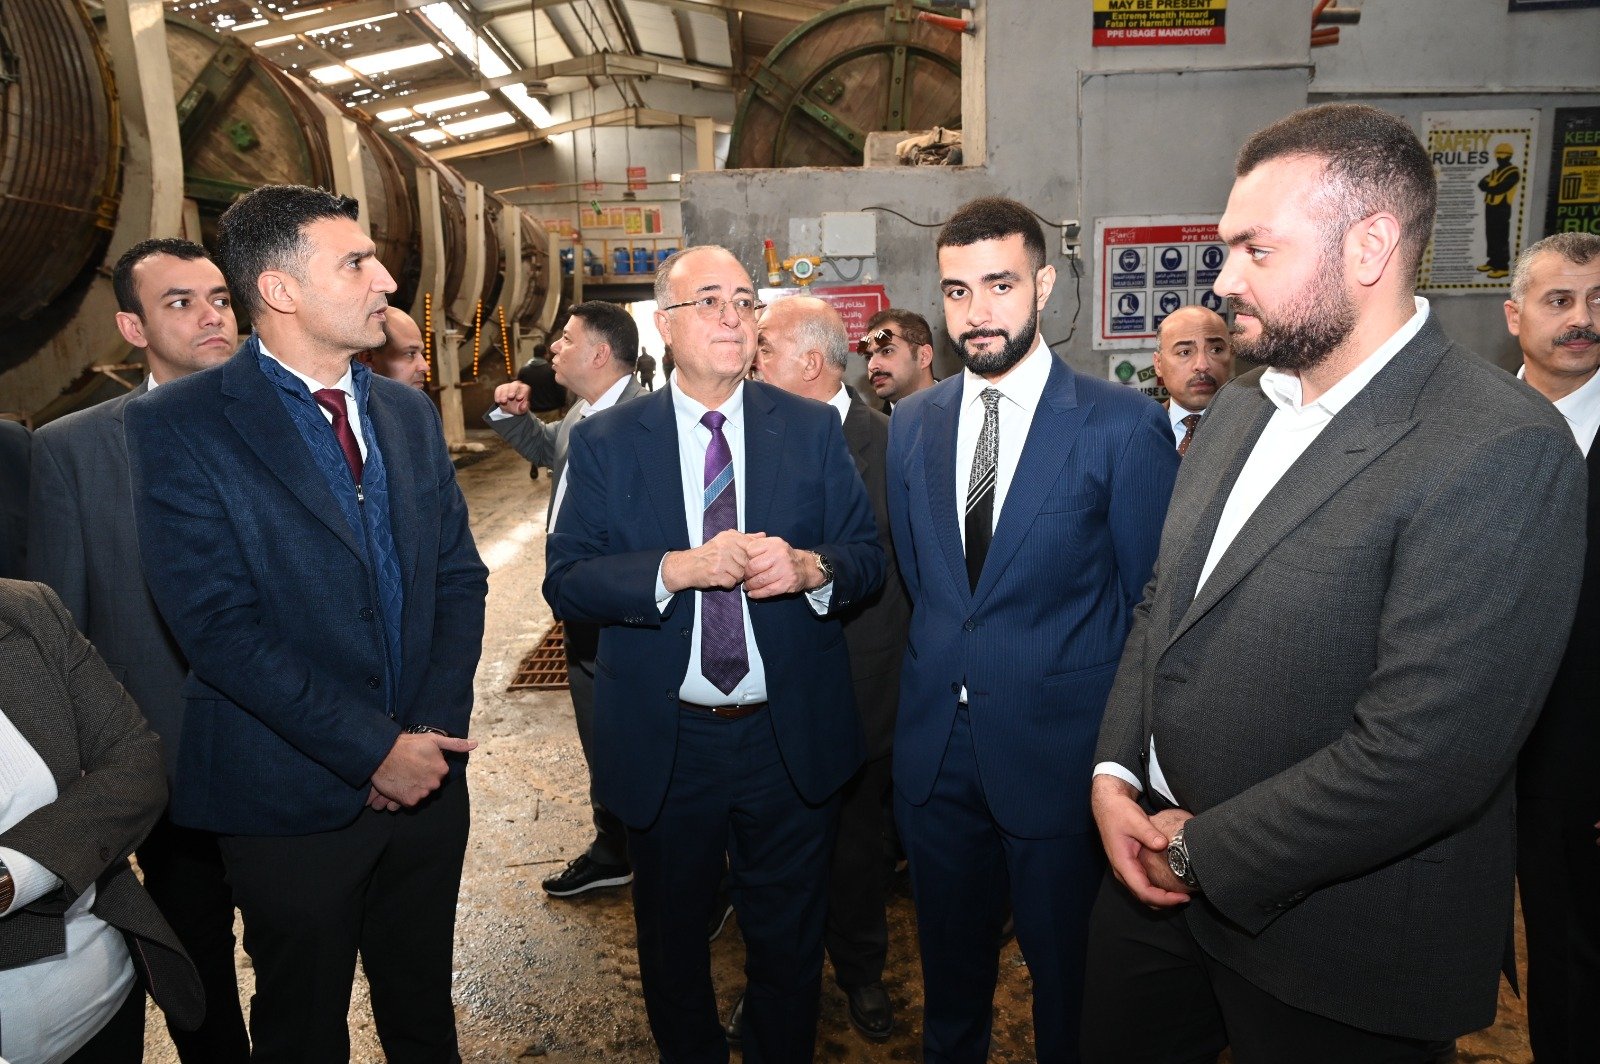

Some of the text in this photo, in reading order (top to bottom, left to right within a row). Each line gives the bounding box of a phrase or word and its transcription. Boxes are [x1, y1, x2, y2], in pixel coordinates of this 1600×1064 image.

[1108, 0, 1212, 10] MAY BE PRESENT
[1112, 10, 1209, 20] Extreme Health Hazard
[1107, 30, 1124, 38] PPE
[1158, 28, 1212, 37] MANDATORY
[1433, 133, 1492, 152] SAFETY
[1432, 152, 1490, 165] RULES
[1557, 206, 1588, 216] PUT
[845, 301, 866, 309] نظام
